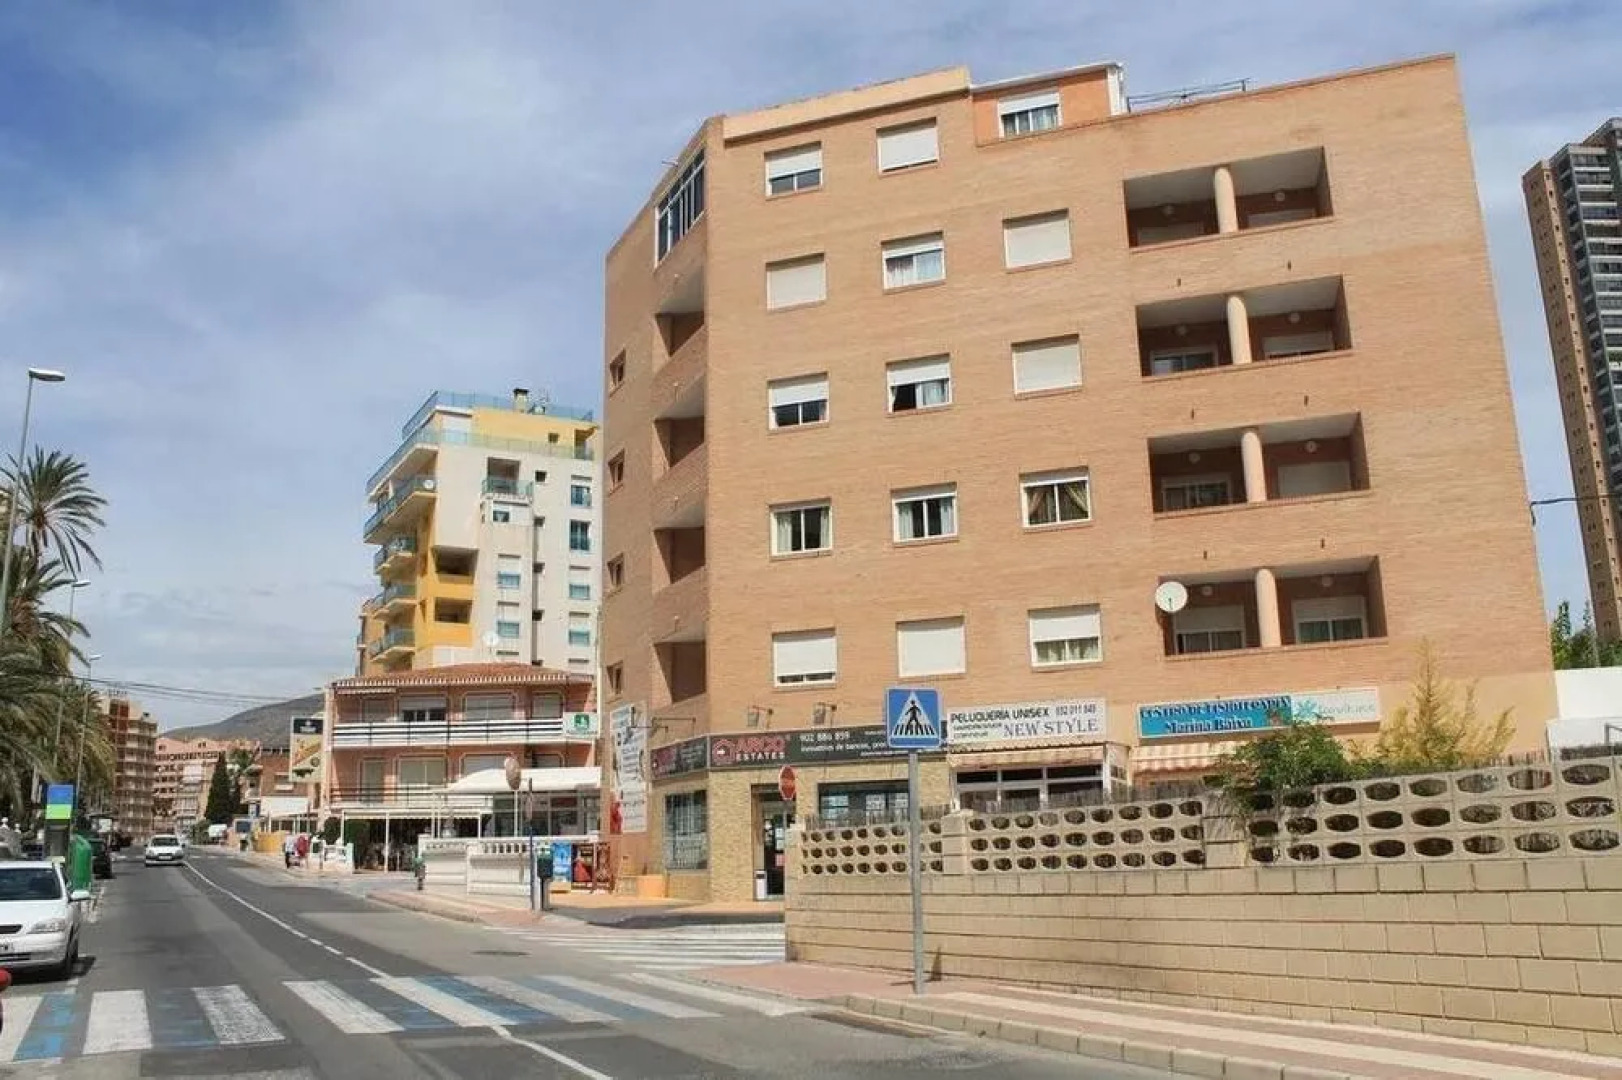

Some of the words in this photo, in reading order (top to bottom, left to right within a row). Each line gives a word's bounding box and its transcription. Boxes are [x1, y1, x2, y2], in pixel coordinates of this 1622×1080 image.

[951, 709, 1010, 723] PELUQUERIA
[1013, 706, 1050, 719] UNISEX
[1003, 719, 1041, 737] NEW
[1044, 716, 1099, 734] STYLE
[1165, 719, 1212, 734] Marina
[1214, 715, 1253, 732] Baixa
[736, 752, 786, 763] ESTATES
